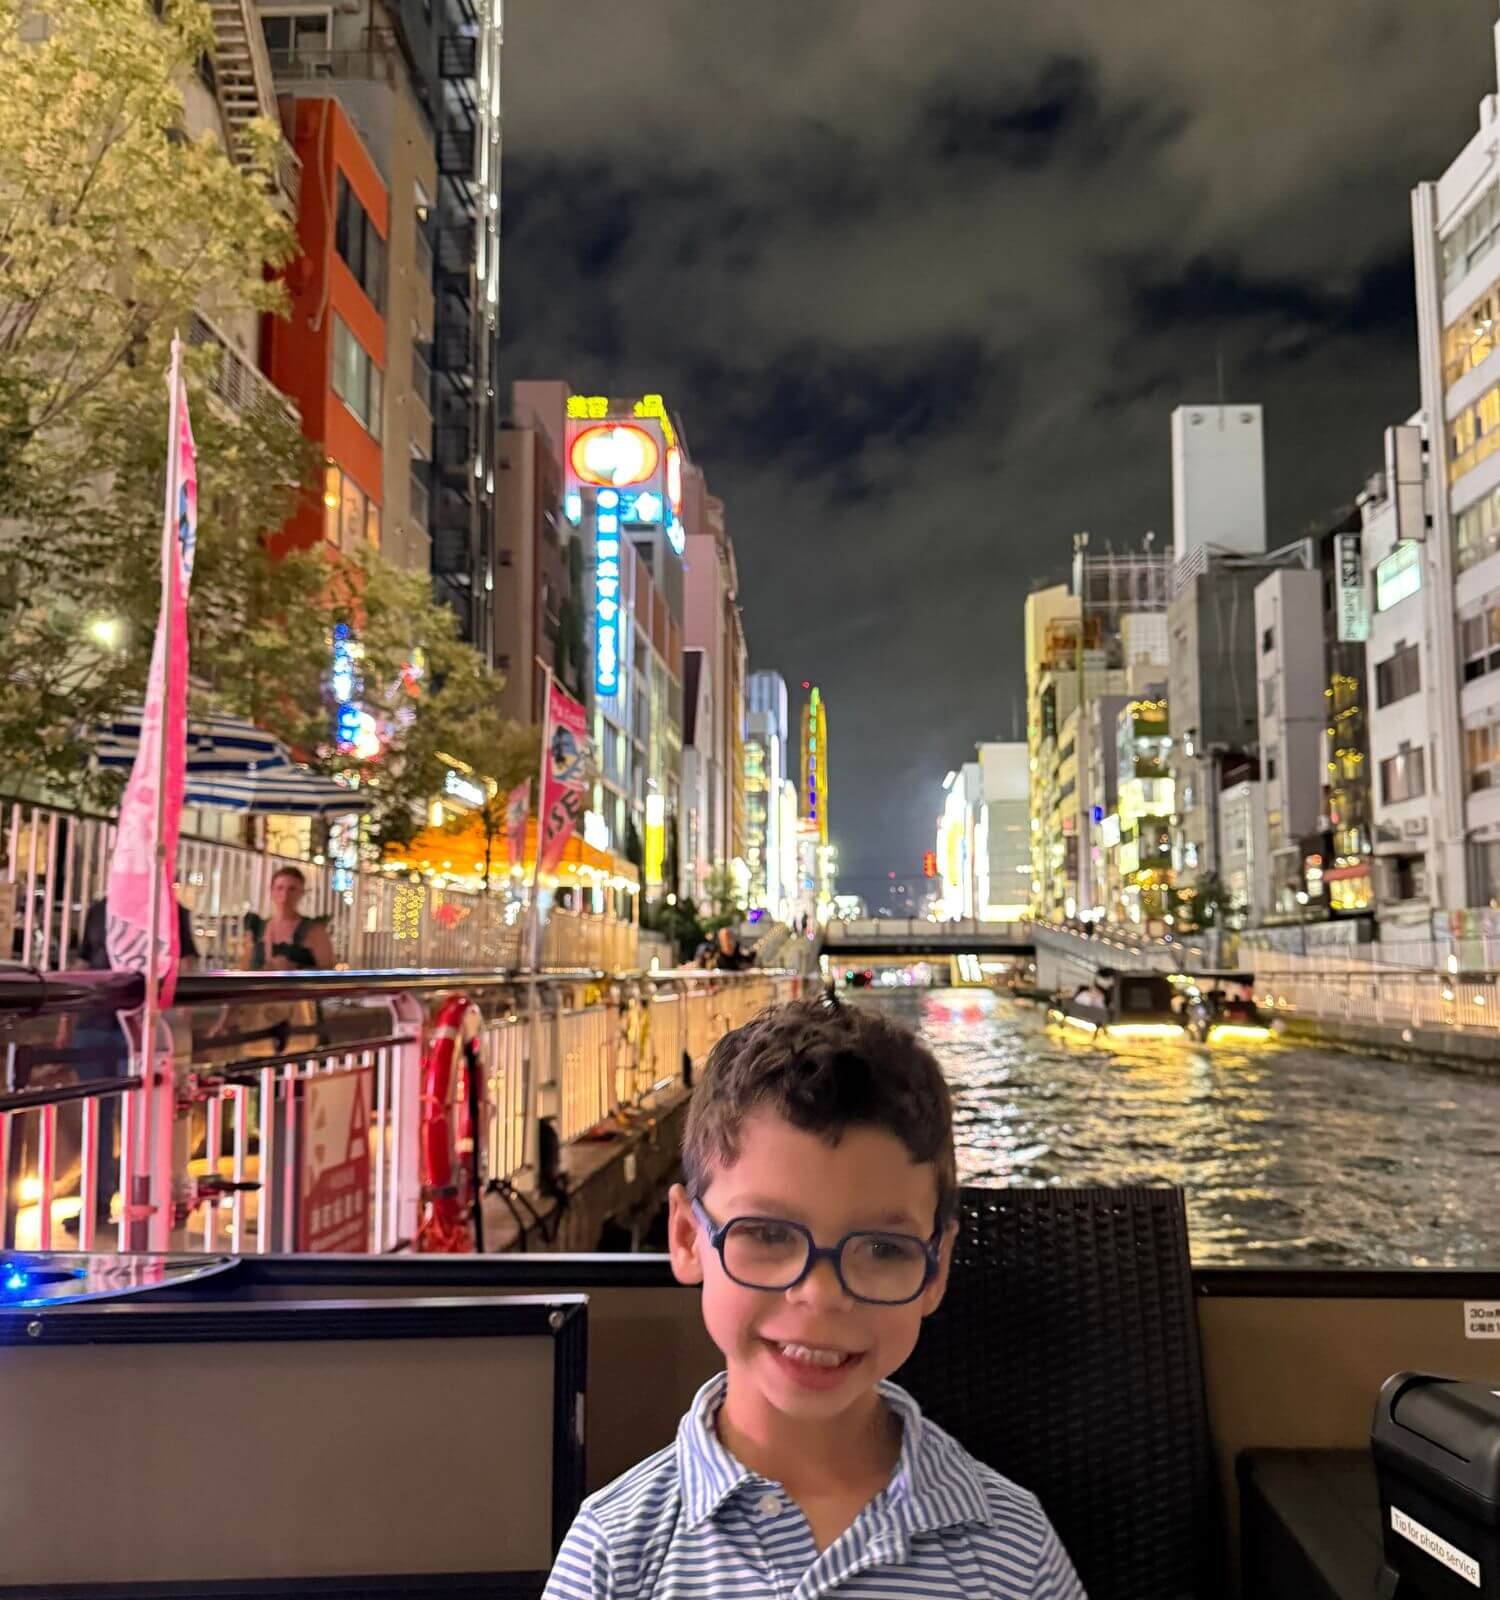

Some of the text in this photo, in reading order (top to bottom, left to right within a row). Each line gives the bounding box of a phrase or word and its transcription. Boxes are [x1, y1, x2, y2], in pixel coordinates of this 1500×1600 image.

[1394, 1513, 1477, 1579] Tip for photo service
